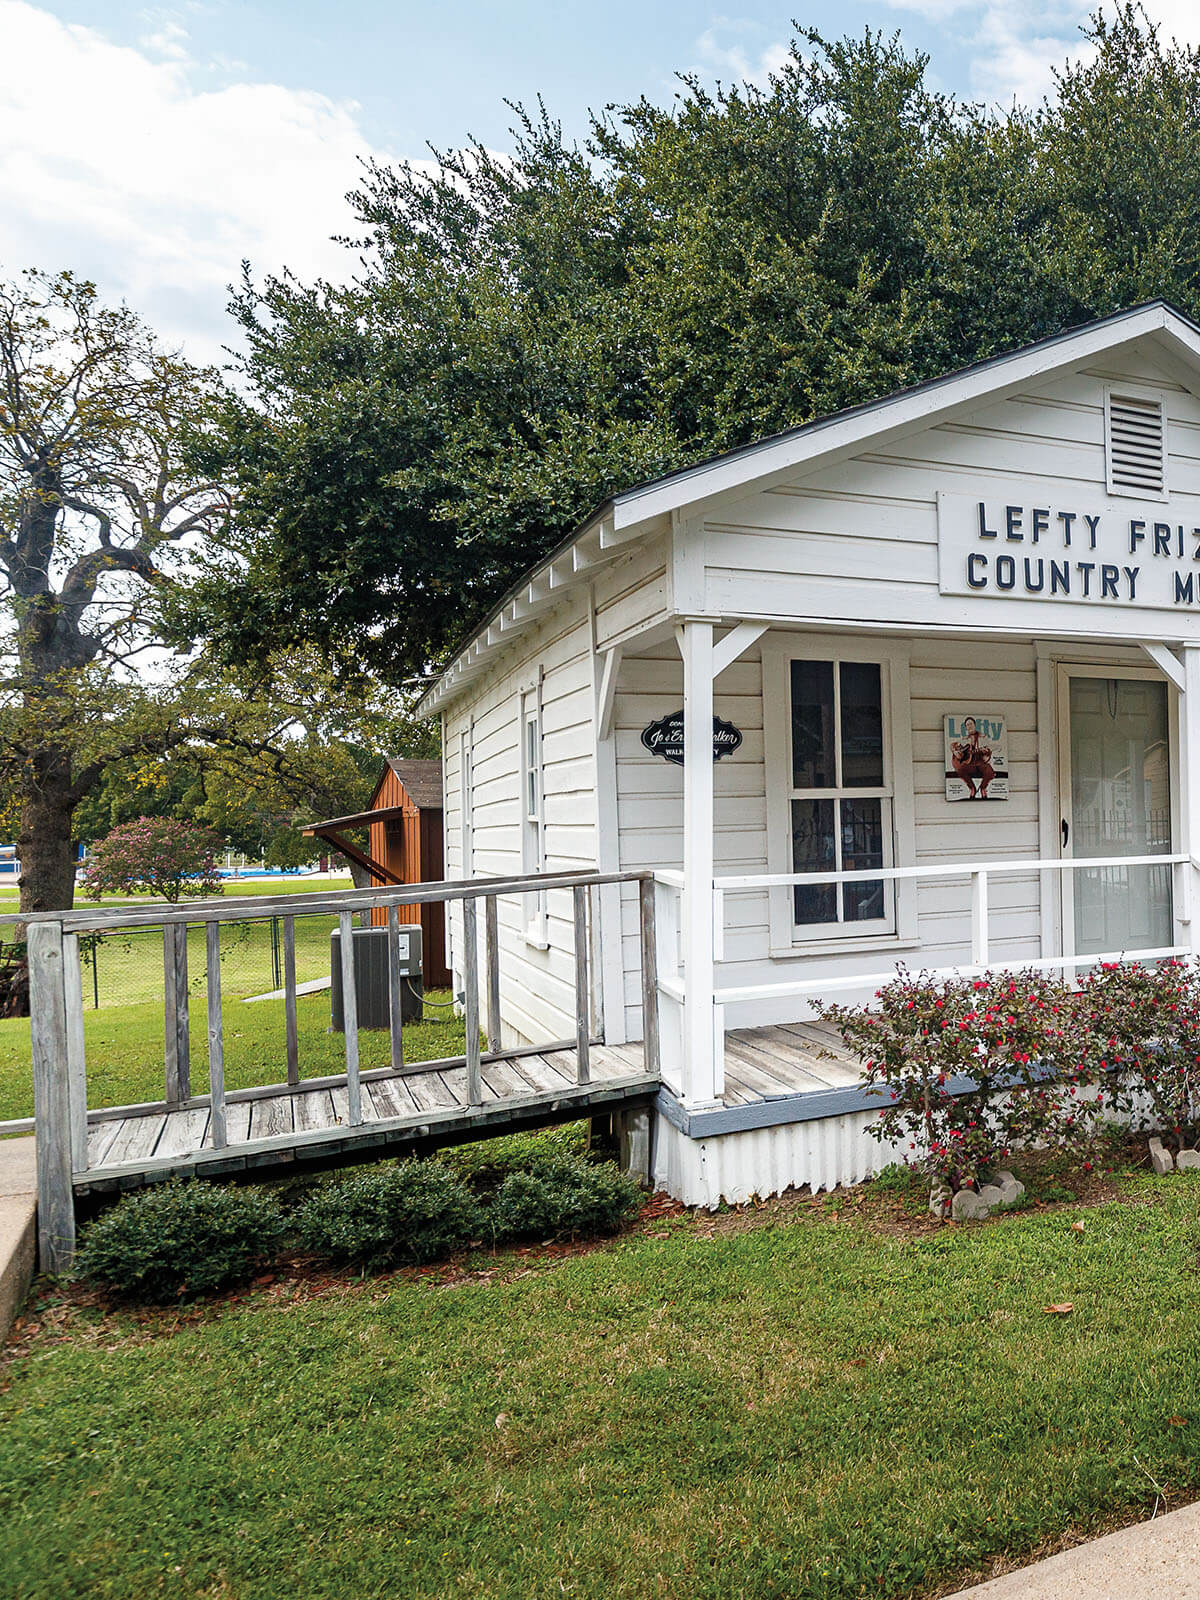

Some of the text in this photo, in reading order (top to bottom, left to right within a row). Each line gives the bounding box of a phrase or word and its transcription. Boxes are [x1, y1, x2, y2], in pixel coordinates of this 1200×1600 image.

[978, 502, 1101, 549] LEFTY
[967, 553, 1140, 600] COUNTRY
[713, 730, 738, 744] alker
